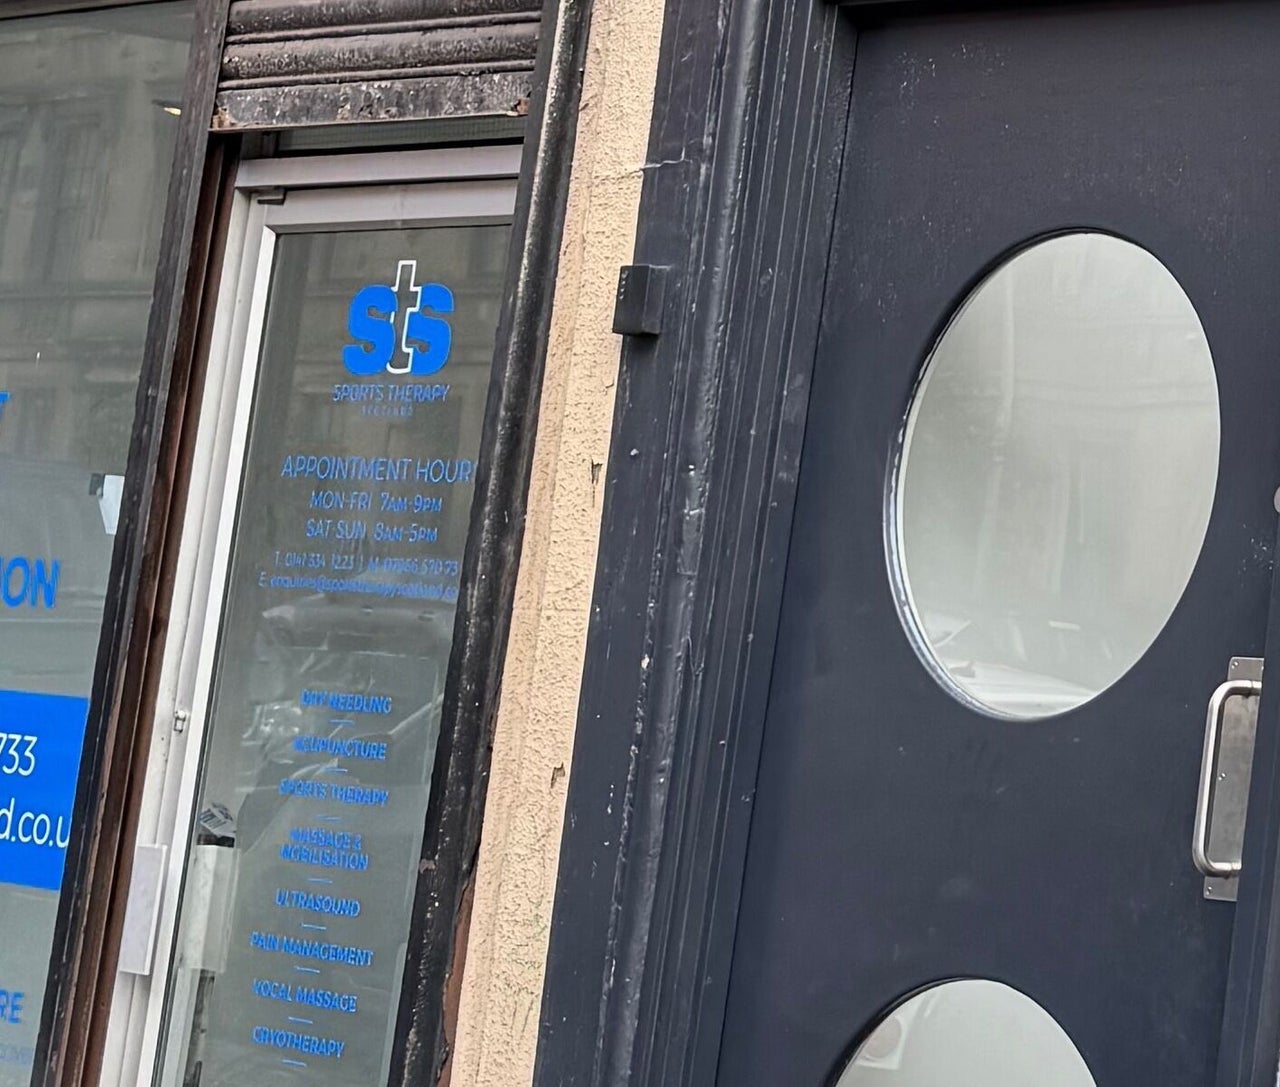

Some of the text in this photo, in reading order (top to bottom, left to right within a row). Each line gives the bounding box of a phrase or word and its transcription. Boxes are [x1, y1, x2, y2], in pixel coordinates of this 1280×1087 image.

[332, 383, 451, 404] SPORTS THERAPY
[281, 454, 477, 483] APPOINTMENT HOUR
[0, 555, 60, 609] ON
[330, 782, 390, 807] THERAPY
[275, 887, 361, 918] ULTRASOUND
[250, 930, 374, 966] PAIN MANAGEMENT
[253, 977, 359, 1013] VOCAL MASSAGE
[253, 1024, 345, 1059] CRYOTHERAPY
